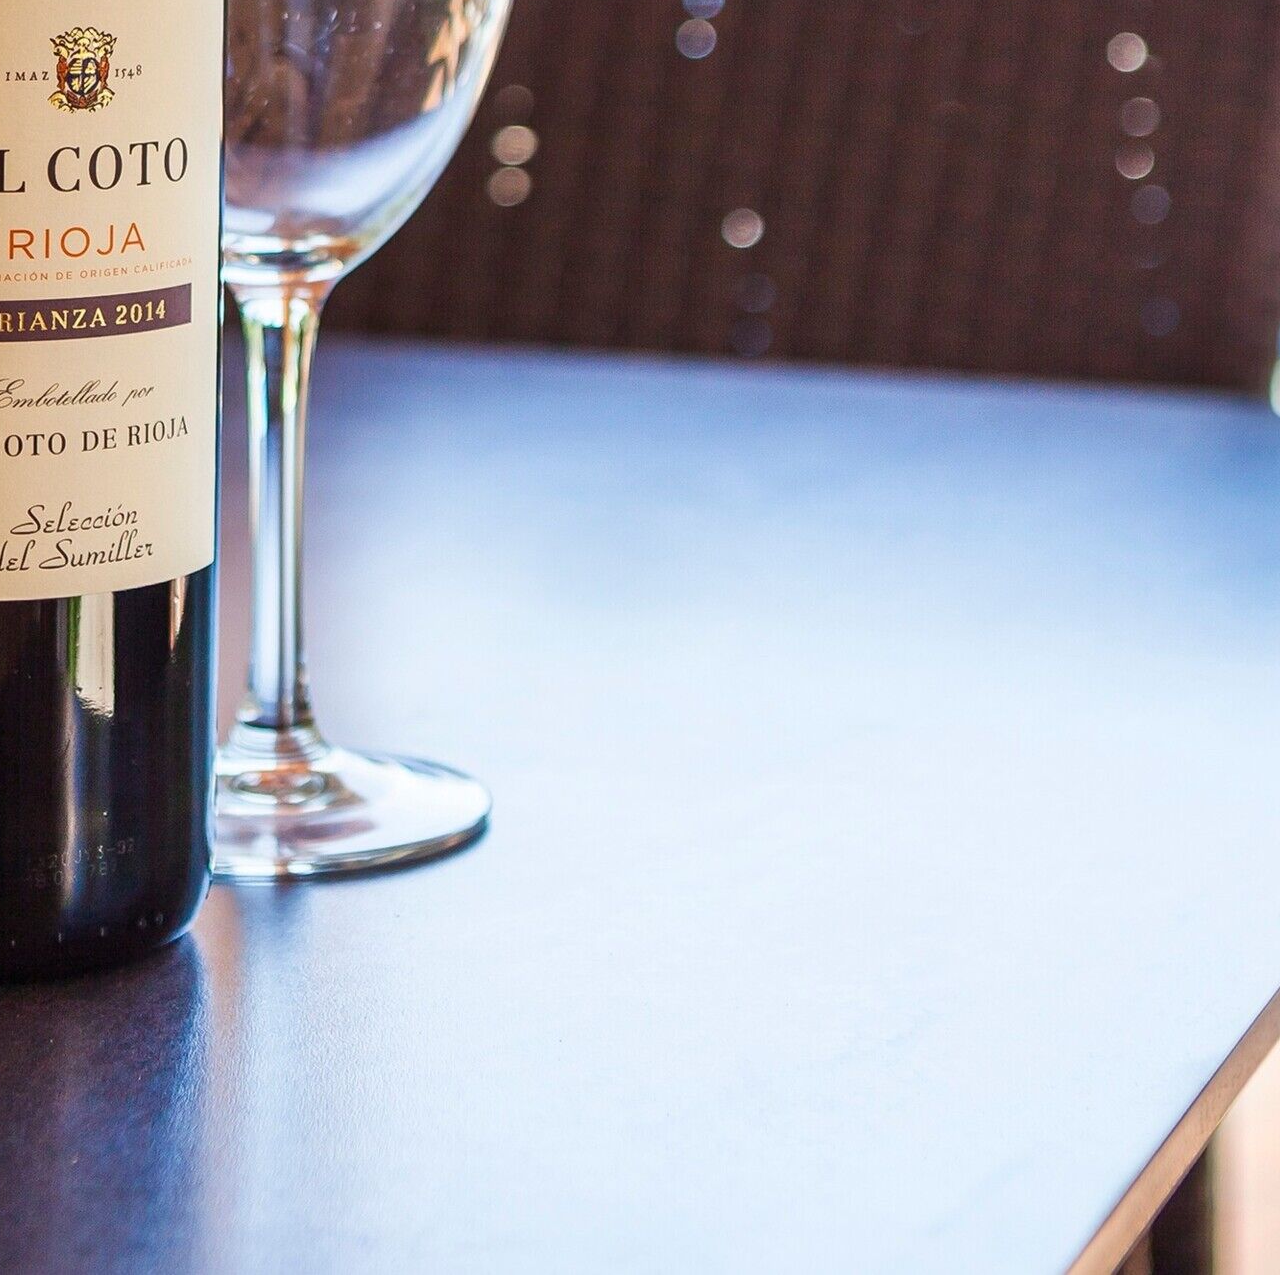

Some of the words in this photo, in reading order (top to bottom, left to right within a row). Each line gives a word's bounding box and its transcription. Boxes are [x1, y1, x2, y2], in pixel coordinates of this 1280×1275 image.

[6, 71, 49, 81] IMAZ
[115, 65, 142, 79] 1548
[46, 137, 188, 193] COTO
[8, 222, 146, 260] RIOJA
[55, 272, 72, 280] DE
[80, 267, 128, 279] ORIGEN
[134, 258, 192, 274] CALIFICADA
[115, 298, 166, 326] 2014
[122, 384, 155, 407] por
[81, 427, 117, 452] DE
[127, 415, 189, 447] RIOJA
[10, 501, 137, 535] Selección
[38, 529, 154, 570] Sumiller
